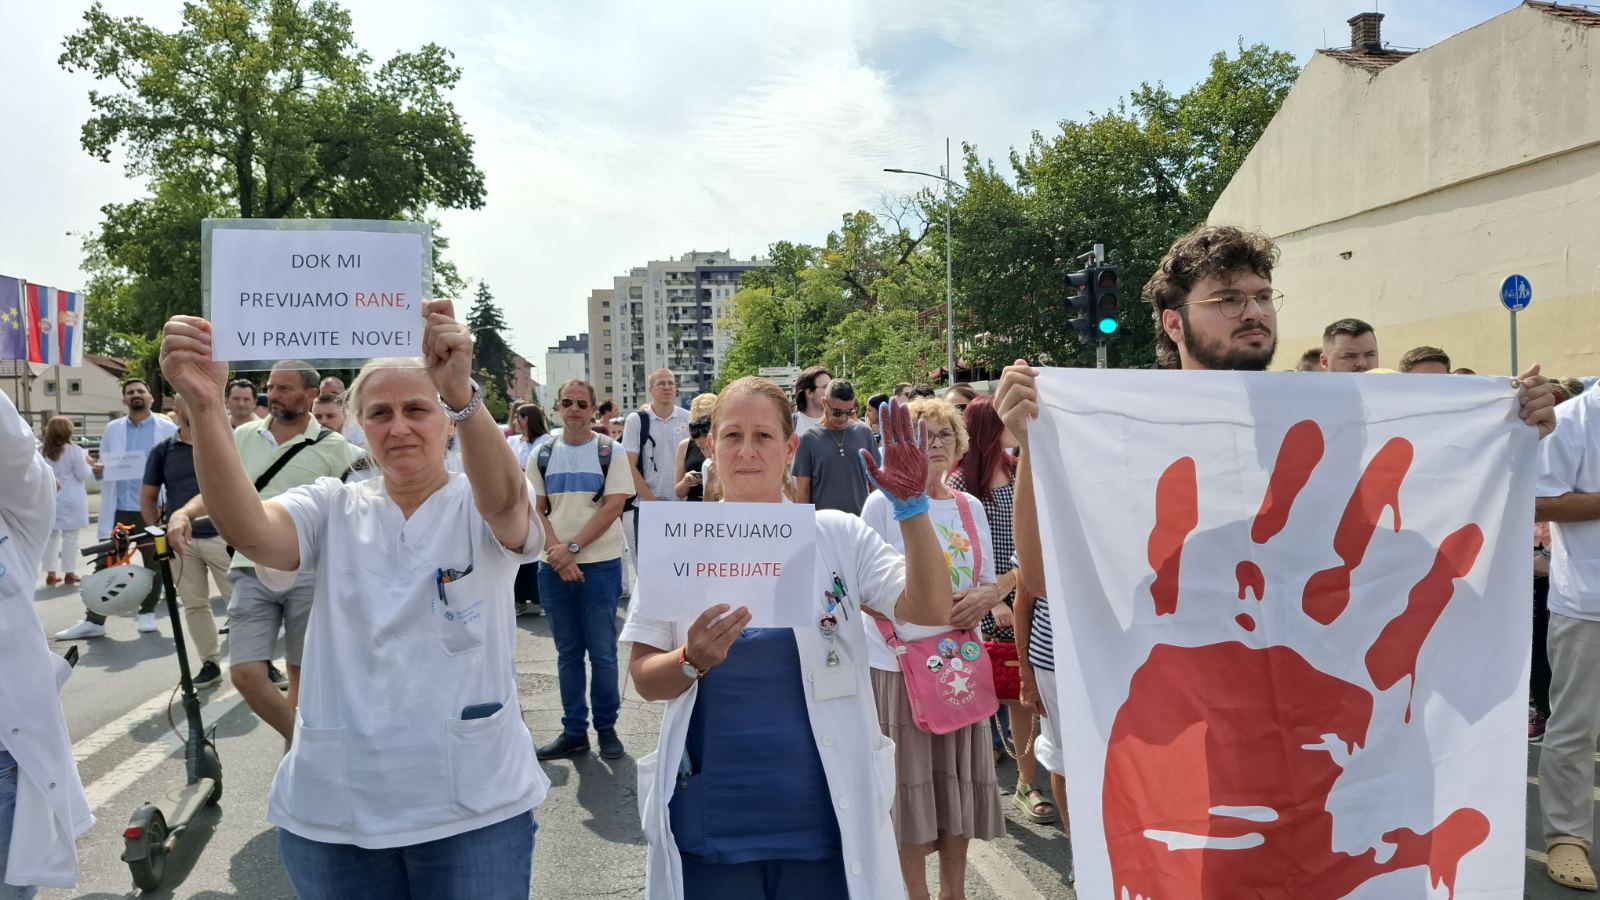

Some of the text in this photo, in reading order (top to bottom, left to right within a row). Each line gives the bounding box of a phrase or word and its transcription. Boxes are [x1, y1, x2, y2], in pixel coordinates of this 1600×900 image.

[291, 253, 361, 269] DOK MI
[240, 292, 411, 310] PREVIJAMO RANE,
[237, 330, 412, 347] VI PRAVITE NOVE!
[664, 522, 793, 539] MI PREVIJAMO
[673, 562, 782, 577] VI PREBIJATE
[948, 696, 960, 705] ALL
